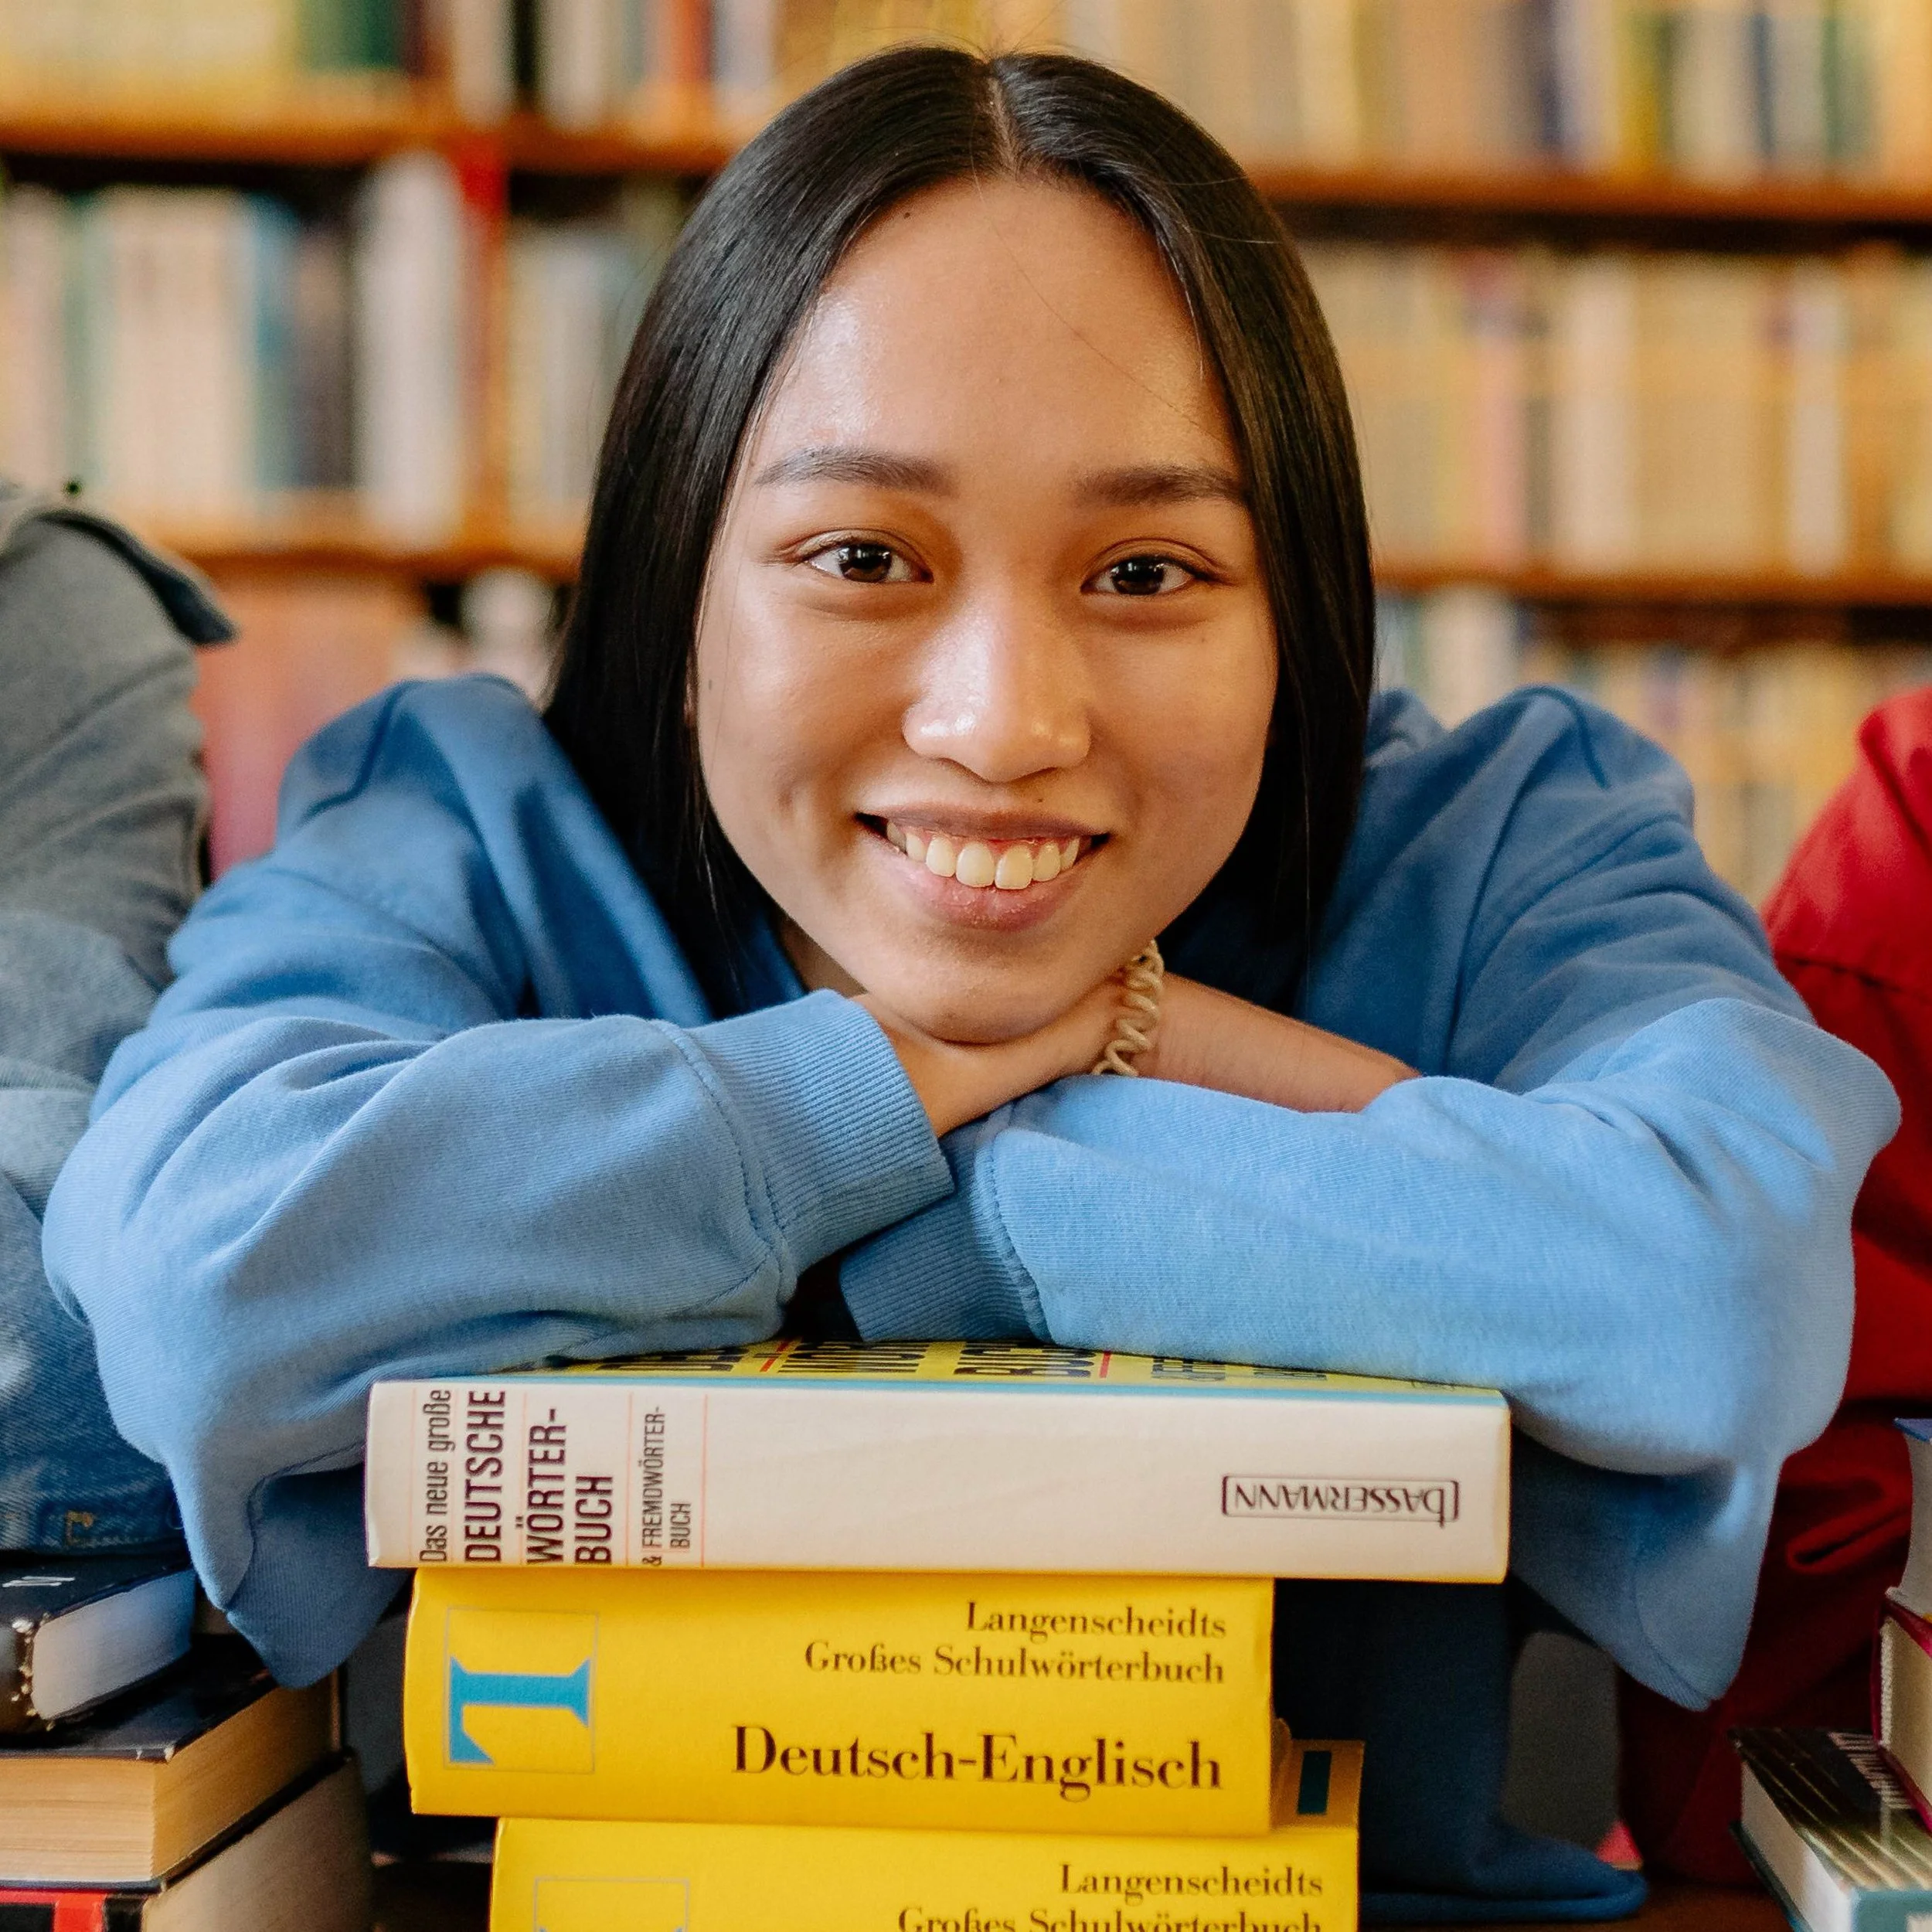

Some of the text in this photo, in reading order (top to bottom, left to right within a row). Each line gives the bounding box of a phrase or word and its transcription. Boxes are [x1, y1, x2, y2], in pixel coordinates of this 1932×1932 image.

[419, 1389, 454, 1563] Das neue große
[464, 1391, 505, 1563] DEUTSCHE
[515, 1409, 566, 1565] WÖRTER-
[638, 1406, 665, 1567] & FREMDWÖRTER-
[574, 1476, 613, 1566] BUCH
[670, 1503, 692, 1549] BUCH
[966, 1600, 1227, 1643] Langenscheidts
[804, 1640, 1225, 1684] Großes Schulwörterbuch
[731, 1723, 1223, 1803] Deutsch-Englisch
[898, 1906, 1323, 1932] Großes Schulwörterbuch
[1060, 1862, 1324, 1906] Langenscheidts
